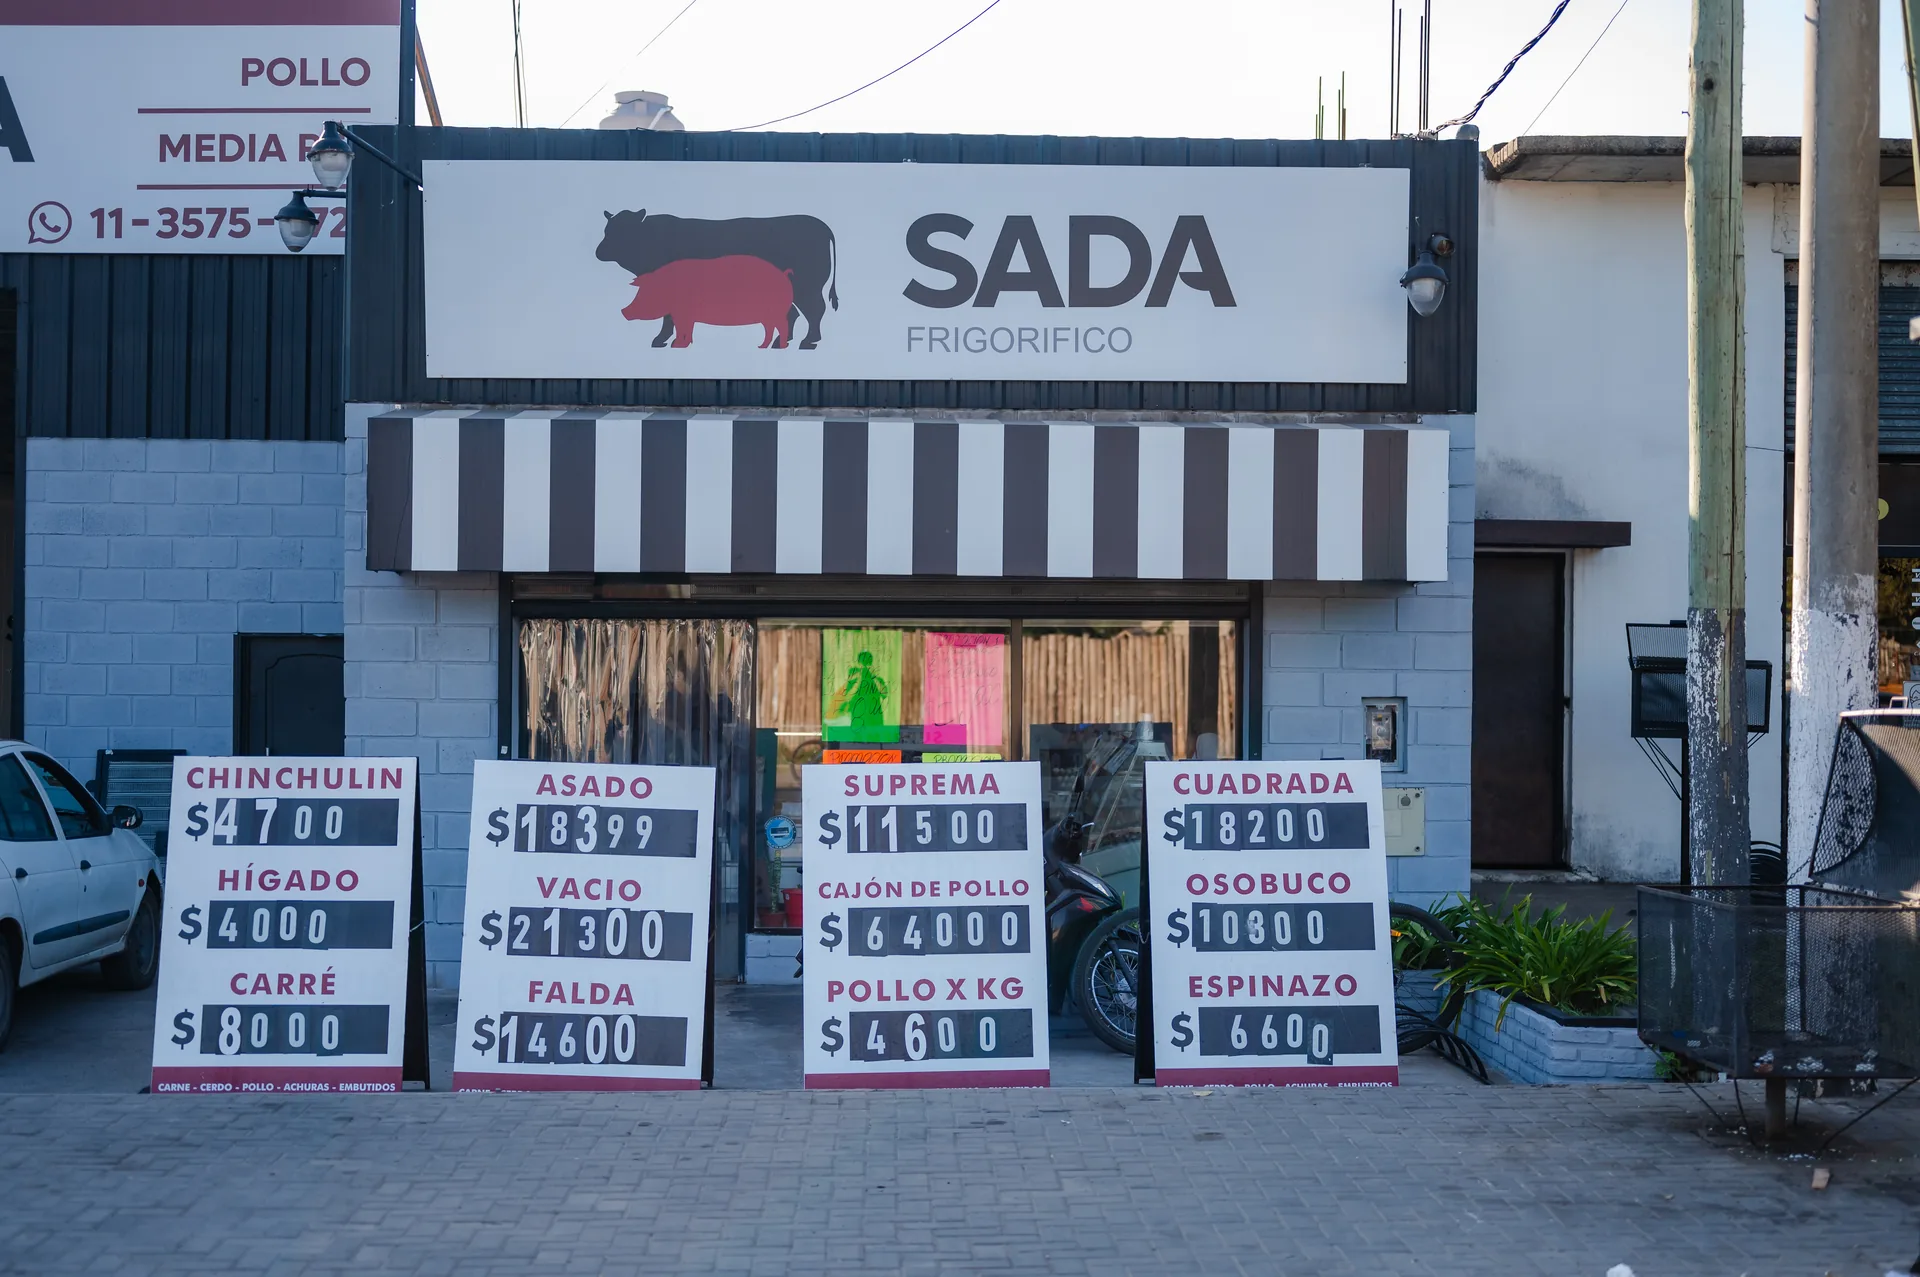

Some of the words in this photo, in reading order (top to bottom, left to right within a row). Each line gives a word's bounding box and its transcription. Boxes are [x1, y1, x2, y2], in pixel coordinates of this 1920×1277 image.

[241, 57, 371, 87] POLLO
[159, 133, 287, 163] MEDIA
[902, 212, 1237, 309] SADA
[907, 326, 1133, 354] FRIGORIFICO
[187, 767, 402, 789] CHINCHULIN
[536, 774, 653, 799] ASADO
[844, 773, 1000, 797] SUPREMA
[1173, 772, 1354, 795] CUADRADA
[218, 862, 359, 892] HÍGADO
[536, 876, 641, 902] VACIO
[818, 877, 901, 899] CAJÓN
[911, 880, 940, 897] DE
[949, 879, 1029, 897] POLLO
[1186, 872, 1351, 895] OSOBUCO
[230, 966, 336, 995] CARRÉ
[528, 980, 635, 1006] FALDA
[827, 978, 936, 1003] POLLO
[946, 978, 967, 1000] X
[977, 977, 1024, 1000] KG
[1189, 973, 1358, 998] ESPINAZO
[158, 1082, 190, 1092] CARNE
[200, 1082, 232, 1092] CERDO
[242, 1082, 274, 1092] POLLO
[283, 1082, 329, 1092] ACHURAS
[339, 1082, 396, 1092] EMBUTIDOS
